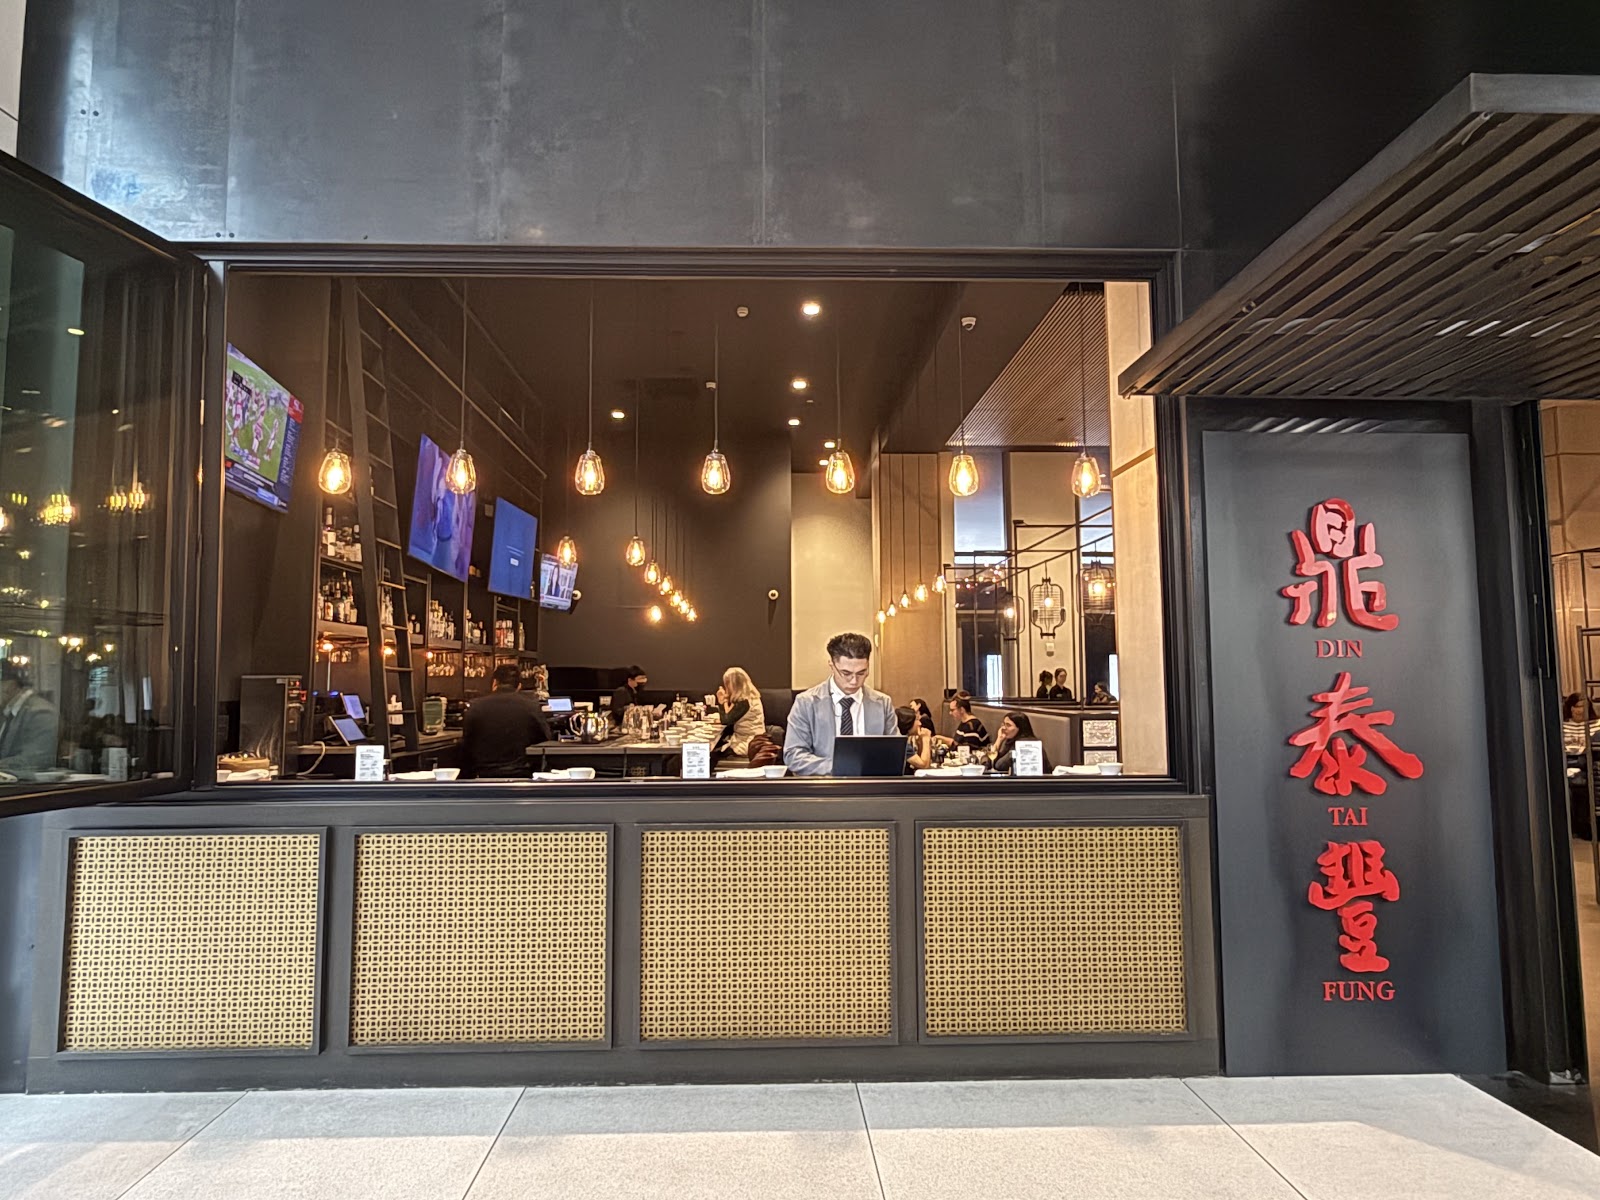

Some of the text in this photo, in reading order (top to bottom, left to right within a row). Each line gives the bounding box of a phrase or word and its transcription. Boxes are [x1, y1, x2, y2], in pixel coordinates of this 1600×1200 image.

[1282, 497, 1400, 631] 鼎
[1315, 639, 1363, 659] DIN
[1289, 672, 1424, 797] 泰
[1328, 806, 1368, 827] TAI
[1322, 980, 1396, 1002] FUNG
